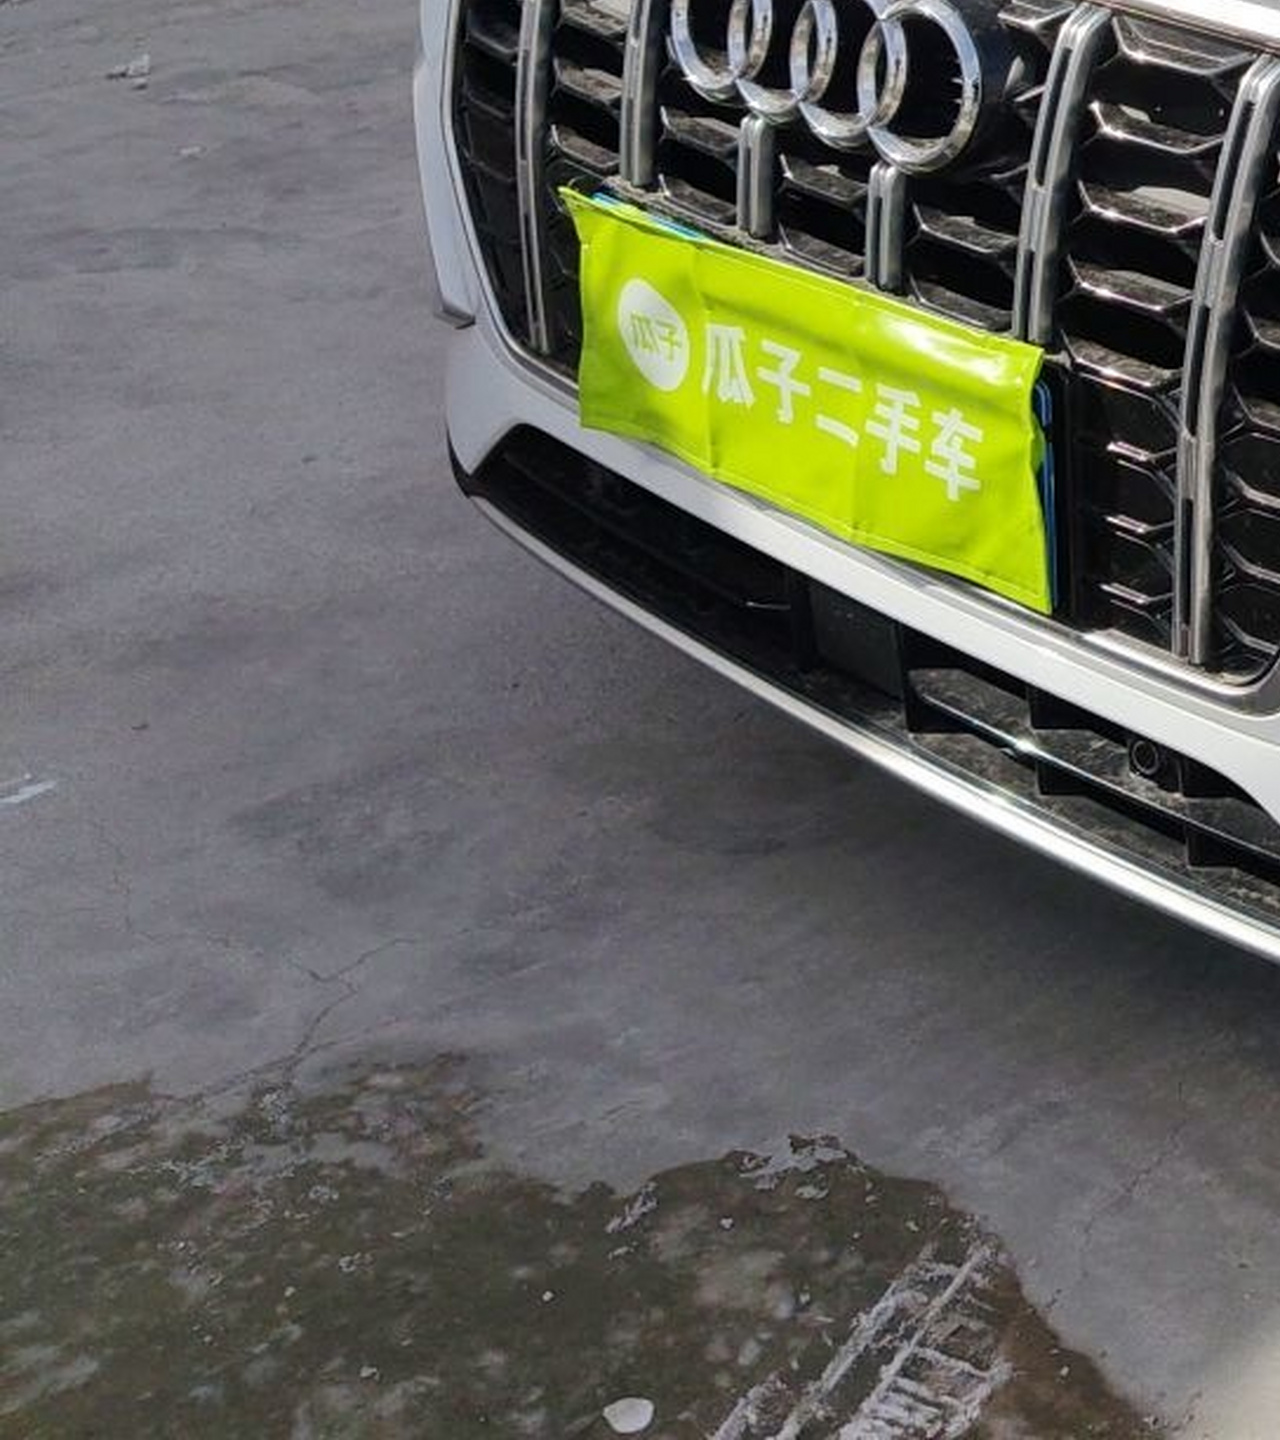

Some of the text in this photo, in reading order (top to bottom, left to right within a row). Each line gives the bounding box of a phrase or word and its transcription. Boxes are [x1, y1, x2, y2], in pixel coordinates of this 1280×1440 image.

[702, 323, 984, 501] 瓜子二手车
